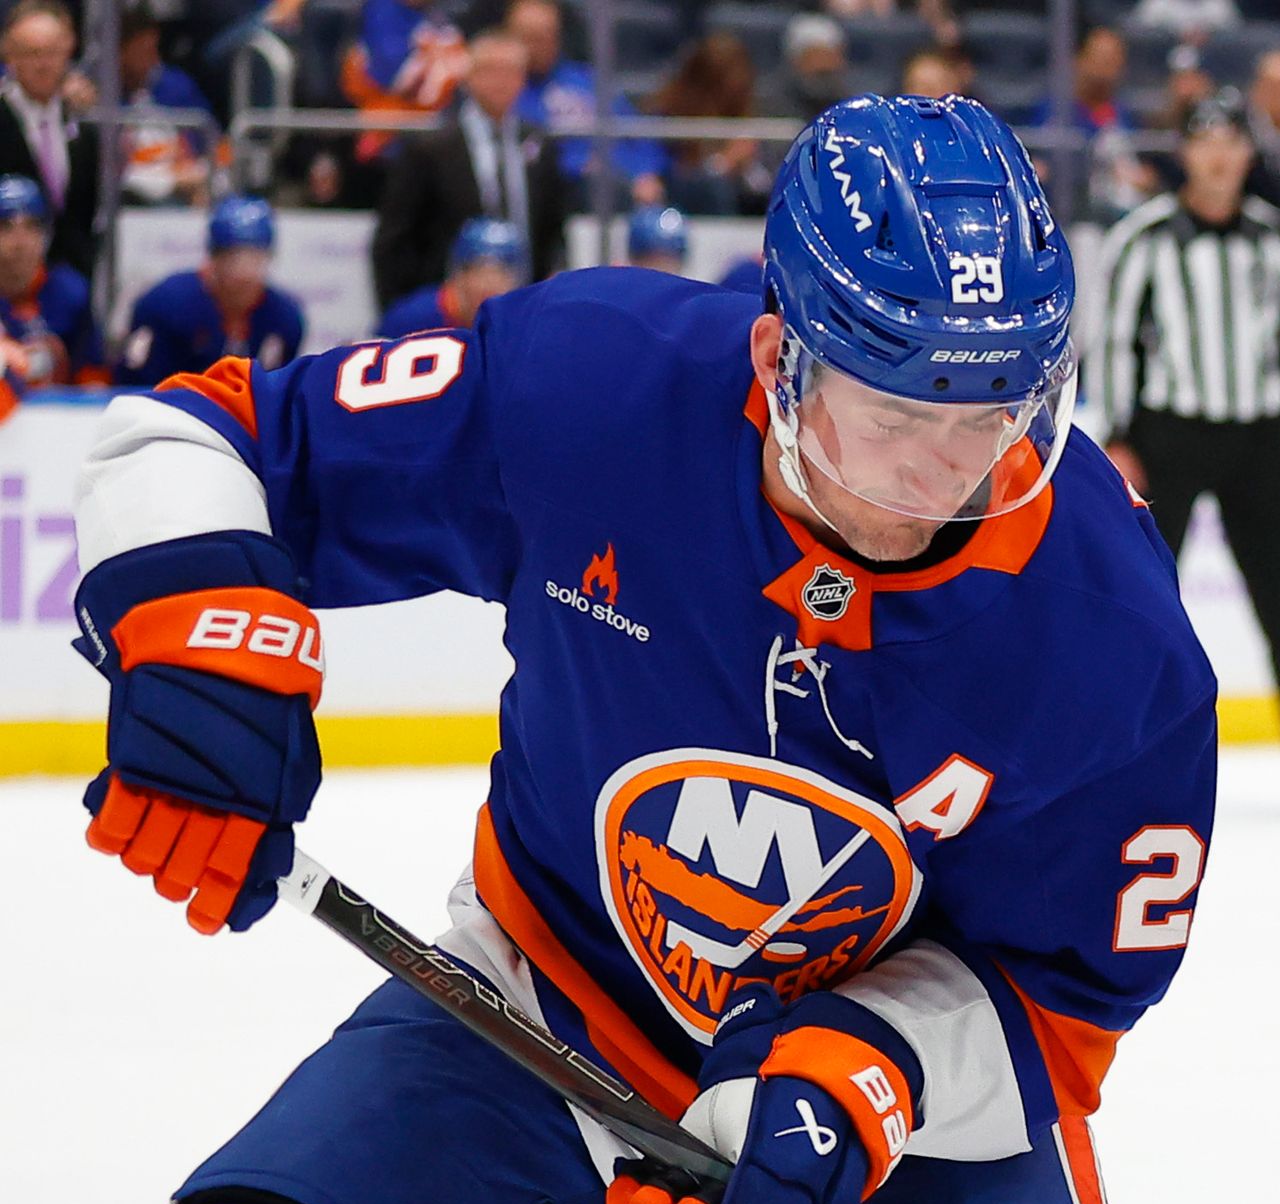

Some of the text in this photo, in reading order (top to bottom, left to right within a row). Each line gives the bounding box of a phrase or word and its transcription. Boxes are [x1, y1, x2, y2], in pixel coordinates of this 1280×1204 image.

[949, 256, 1005, 304] 29
[929, 349, 1022, 364] BAUER
[545, 579, 651, 642] solo stove
[810, 584, 845, 601] NHL
[893, 752, 995, 841] A
